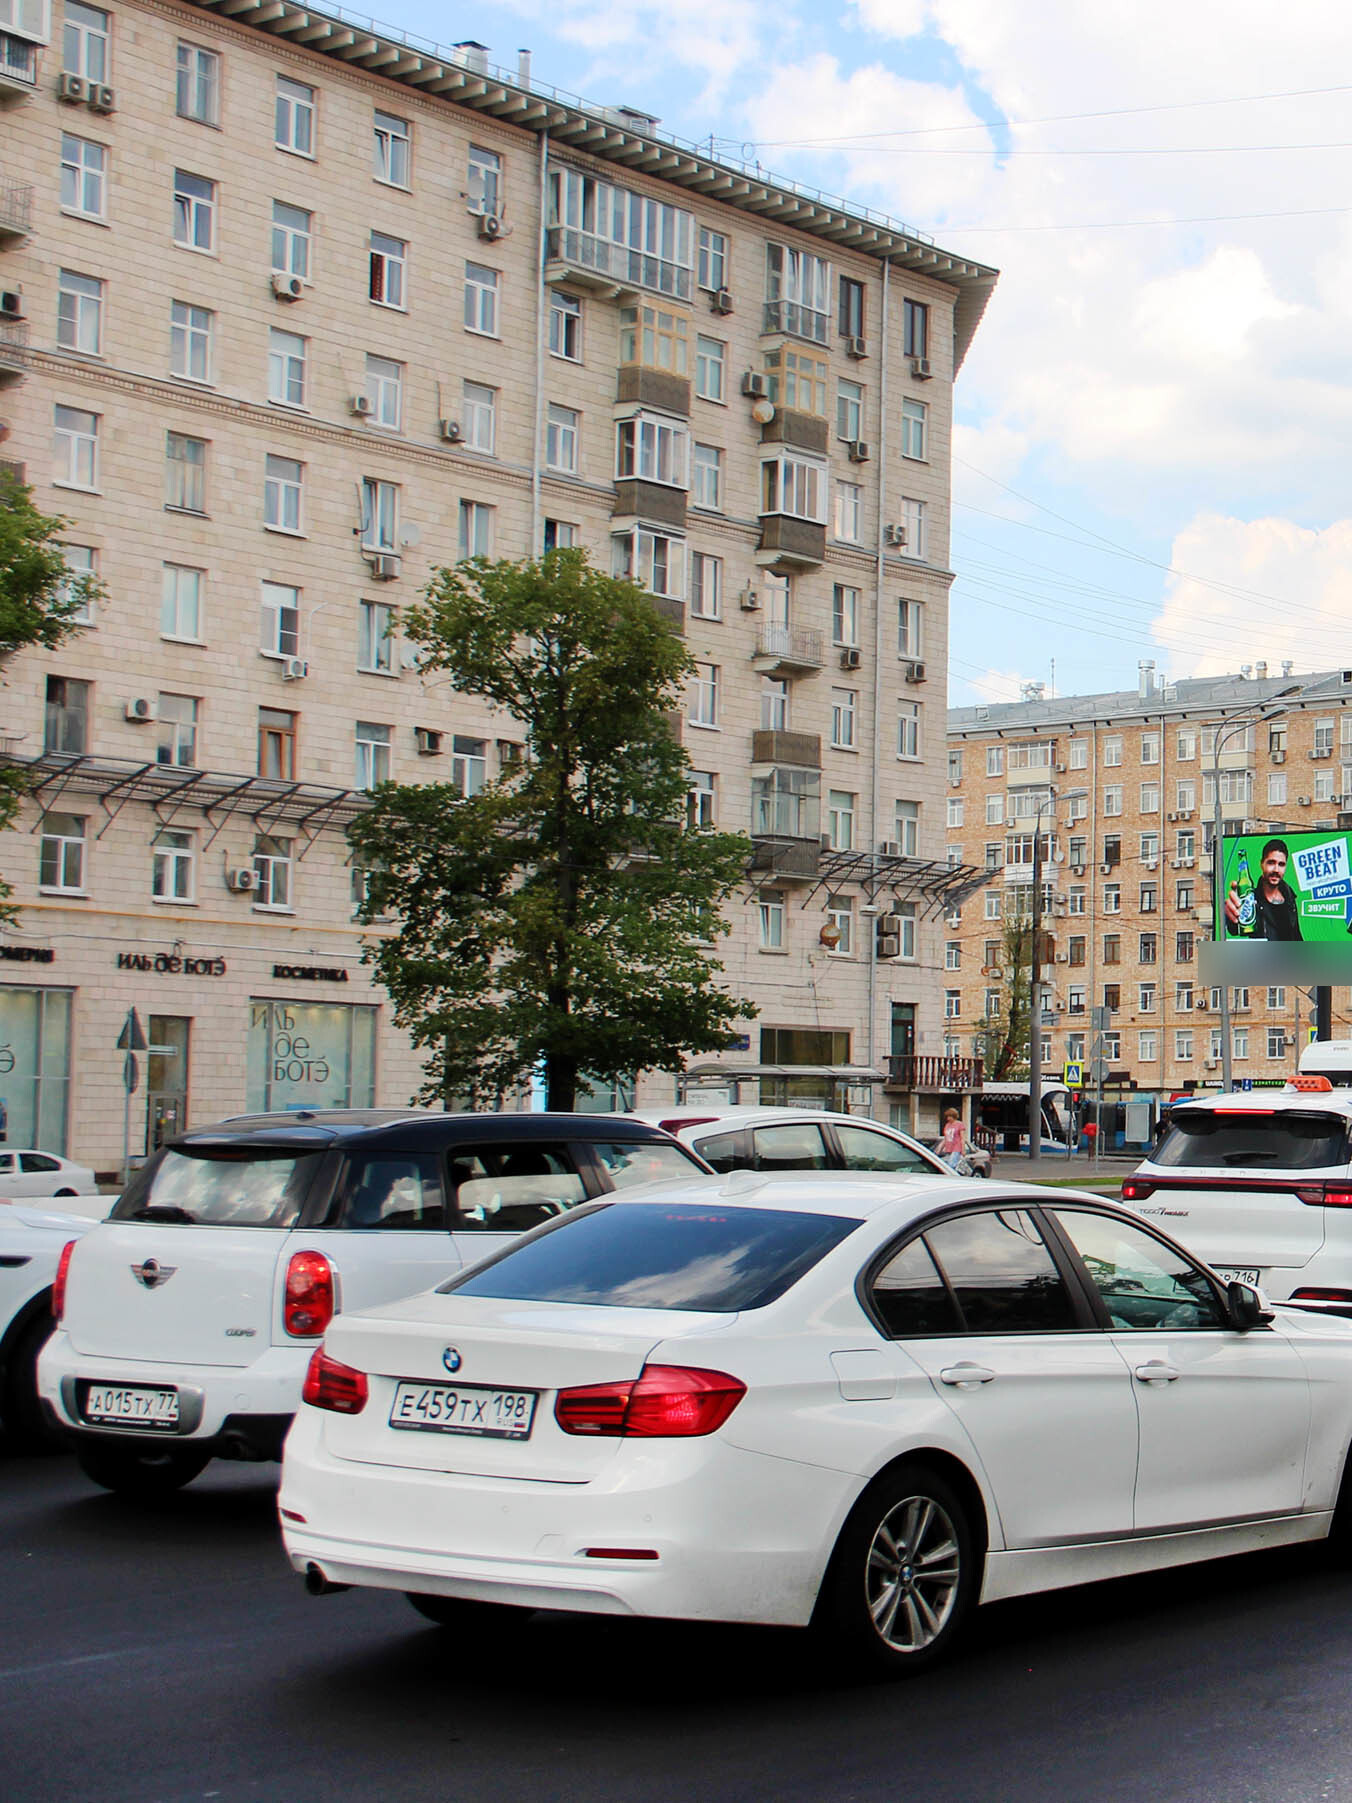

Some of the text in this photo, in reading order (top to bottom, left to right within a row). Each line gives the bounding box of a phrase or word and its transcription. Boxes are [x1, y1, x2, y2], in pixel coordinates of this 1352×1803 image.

[1298, 845, 1342, 868] GREEN
[1305, 860, 1338, 880] BEAT
[1316, 884, 1347, 897] КРУТО
[1307, 903, 1340, 913] ЗВУЧИТ
[117, 953, 152, 971] ИЛЬ
[1234, 1271, 1253, 1283] 716
[93, 1390, 175, 1416] А015ТХ 77
[399, 1389, 527, 1423] Е459ТХ 198
